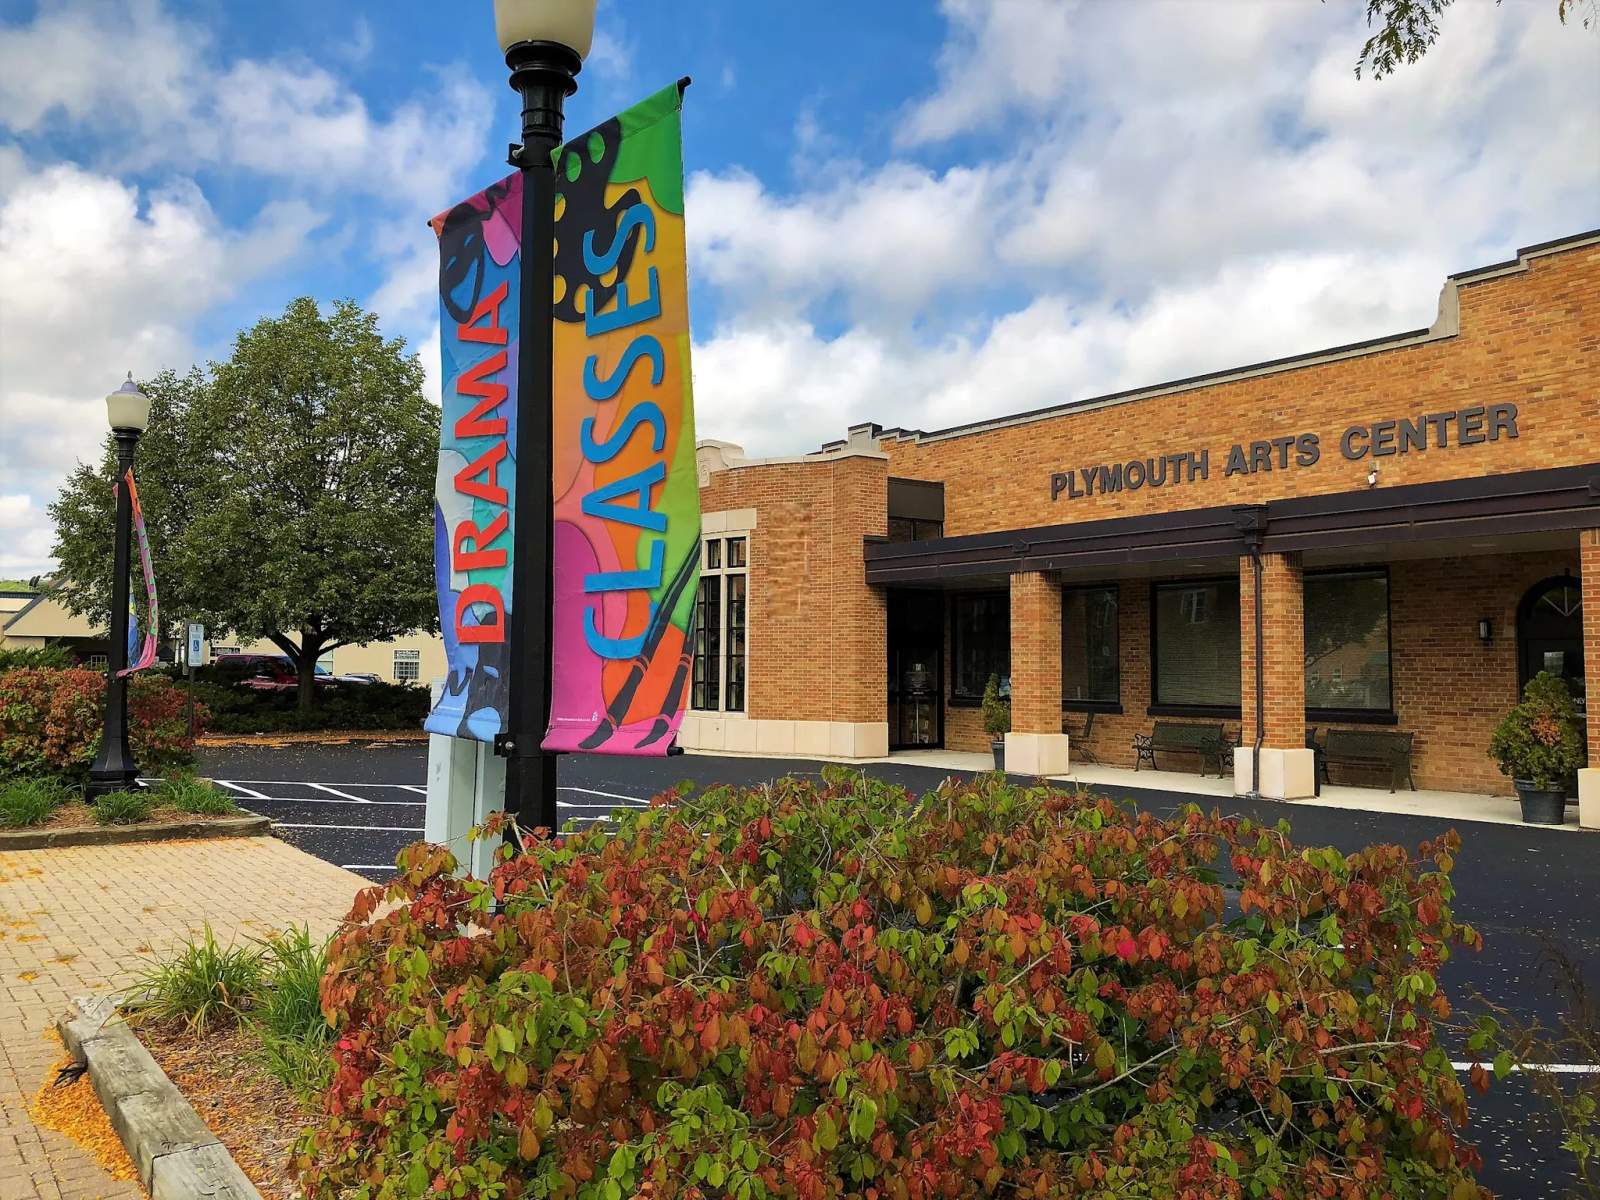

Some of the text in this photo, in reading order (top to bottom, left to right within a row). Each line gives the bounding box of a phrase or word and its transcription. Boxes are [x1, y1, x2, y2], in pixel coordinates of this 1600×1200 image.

[453, 281, 508, 645] DRAMA
[580, 202, 667, 660] CLASSES
[1050, 402, 1519, 500] PLYMOUTH ARTS CENTER
